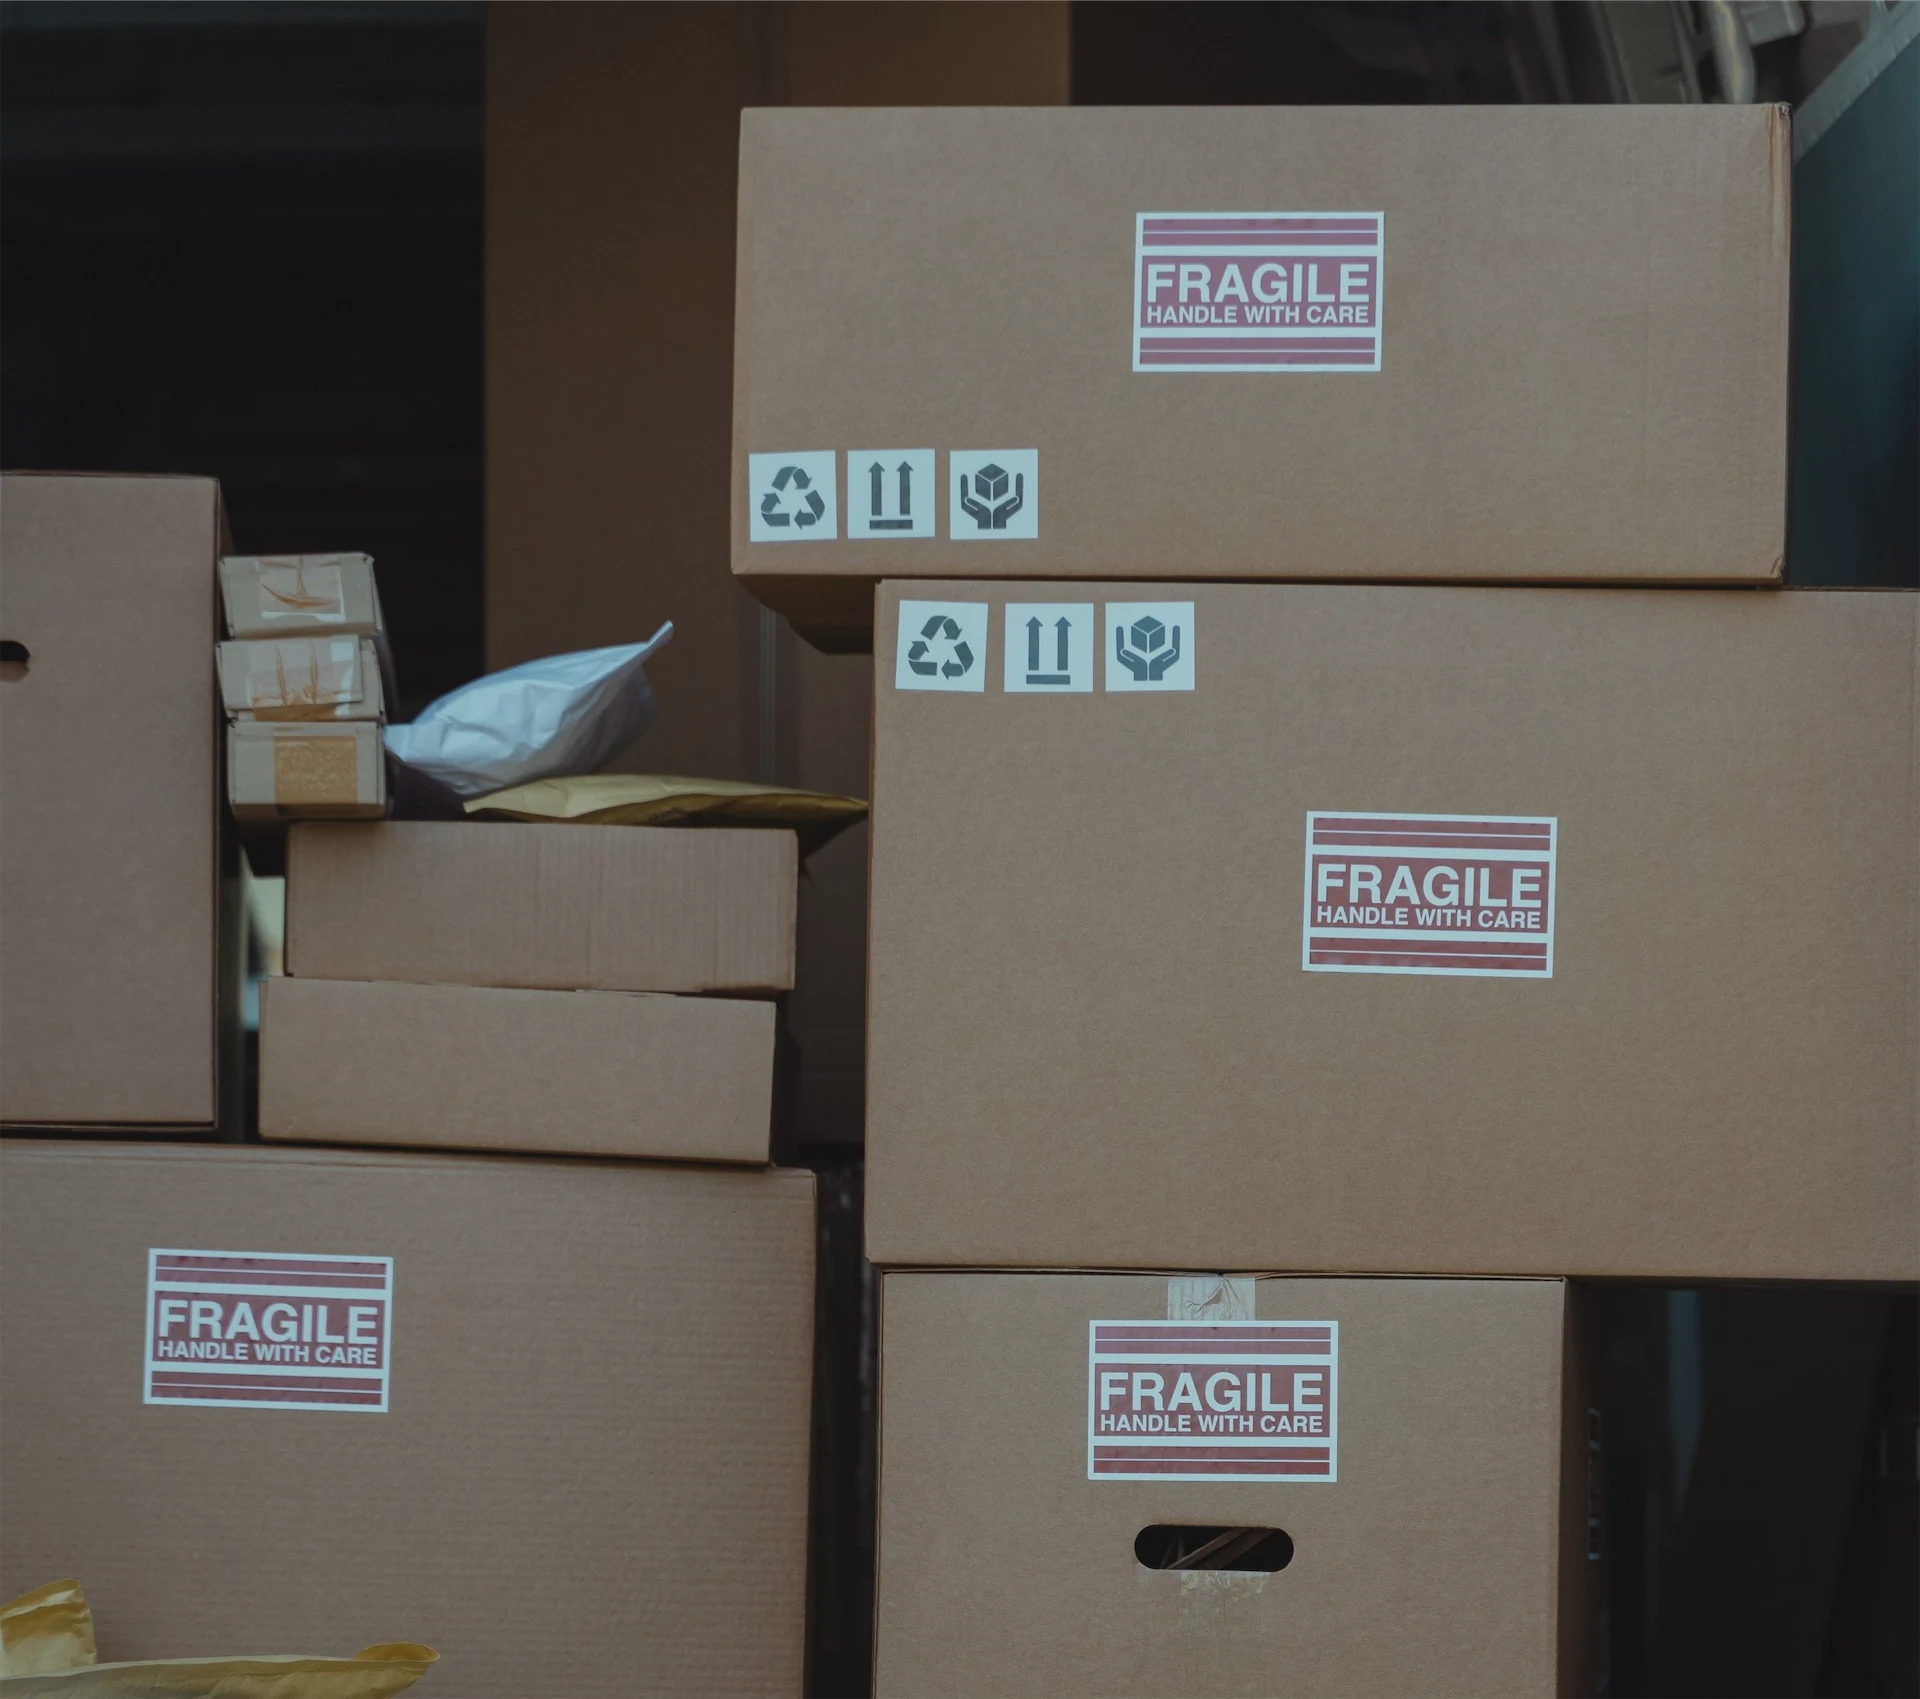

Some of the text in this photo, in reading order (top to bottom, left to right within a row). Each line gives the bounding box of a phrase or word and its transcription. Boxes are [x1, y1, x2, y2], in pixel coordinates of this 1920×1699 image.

[1147, 263, 1370, 303] FRAGILE
[1147, 305, 1369, 324] HANDLE WITH CARE
[1317, 863, 1542, 908] FRAGILE
[1316, 905, 1541, 929] HANDLE WITH CARE
[158, 1299, 378, 1345] FRAGILE
[157, 1340, 377, 1365] HANDLE WITH CARE
[1100, 1371, 1324, 1412] FRAGILE
[1100, 1413, 1323, 1433] HANDLE WITH CARE
